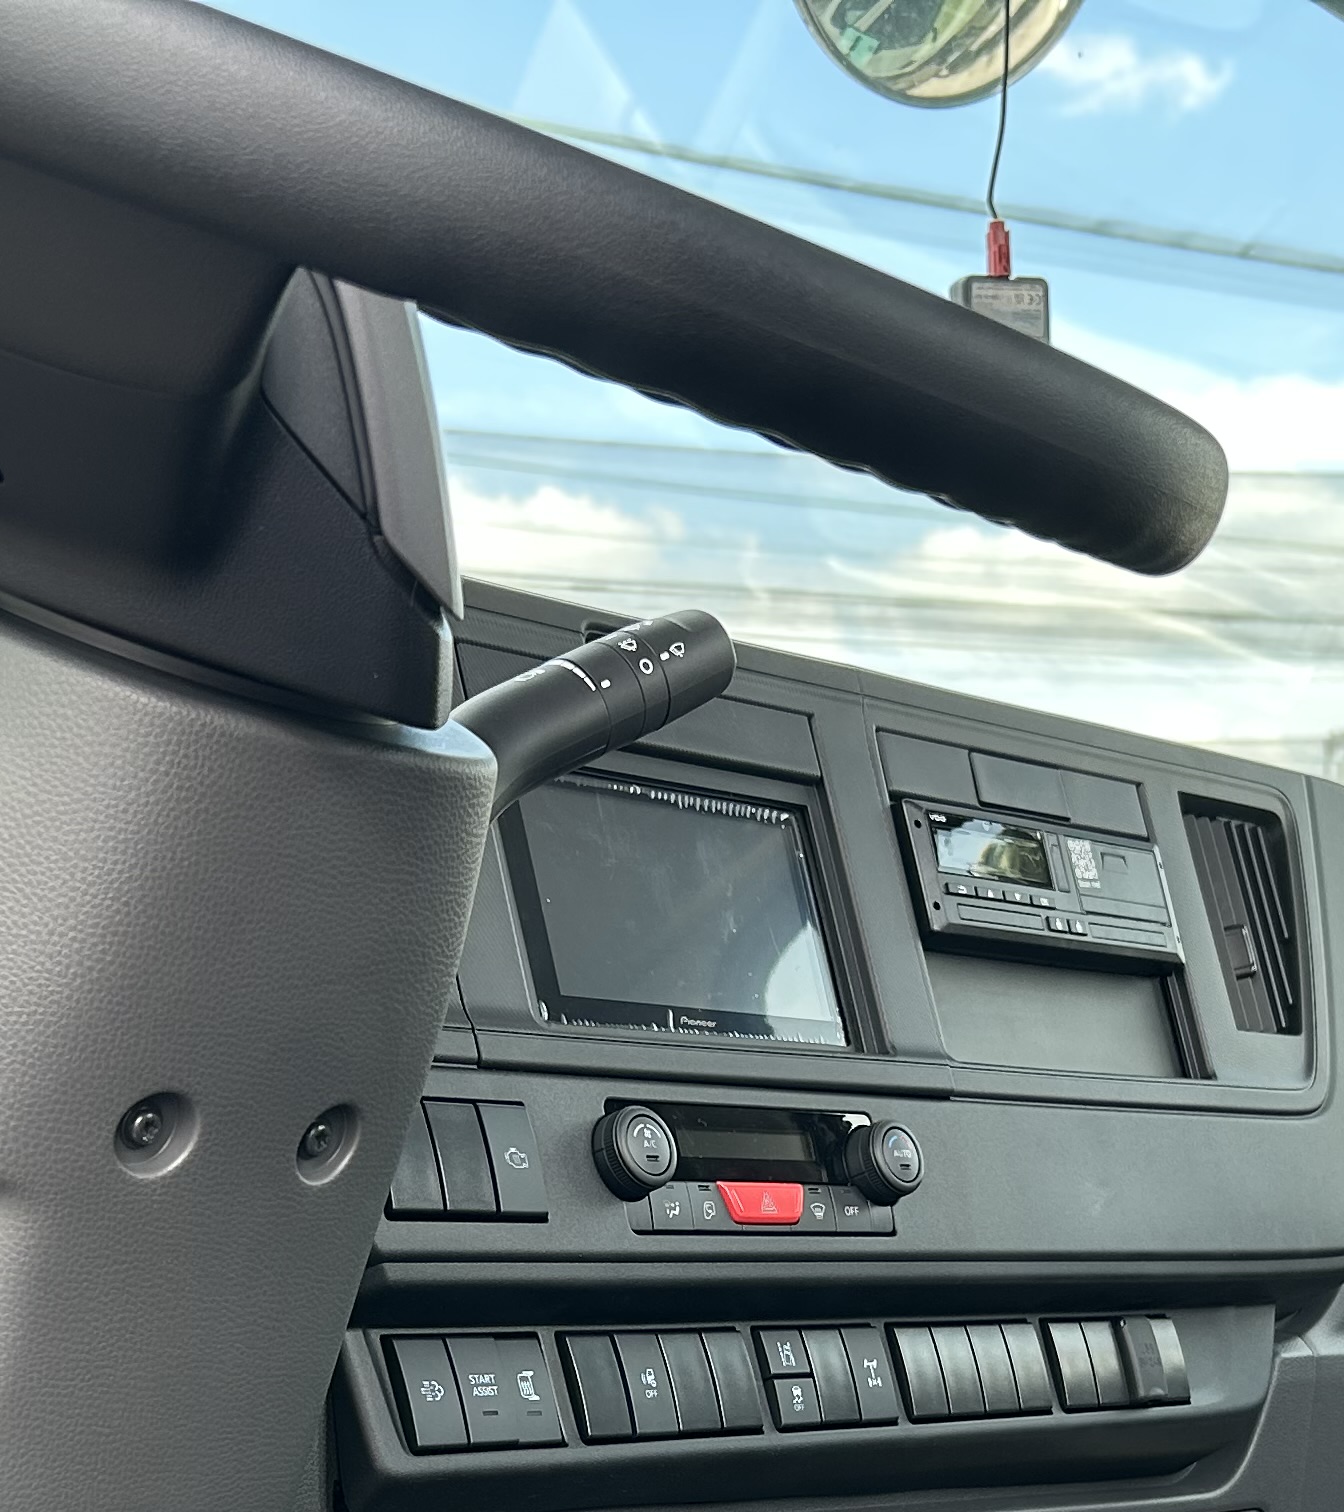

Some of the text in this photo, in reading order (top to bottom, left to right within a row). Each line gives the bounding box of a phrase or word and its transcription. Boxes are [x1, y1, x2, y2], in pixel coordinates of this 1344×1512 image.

[643, 1139, 658, 1149] A/C
[893, 1149, 912, 1159] AUTO
[844, 1205, 860, 1217] OFF
[468, 1374, 496, 1385] START
[473, 1385, 499, 1397] ASSIST
[645, 1389, 658, 1399] OFF
[793, 1403, 805, 1412] OFF
